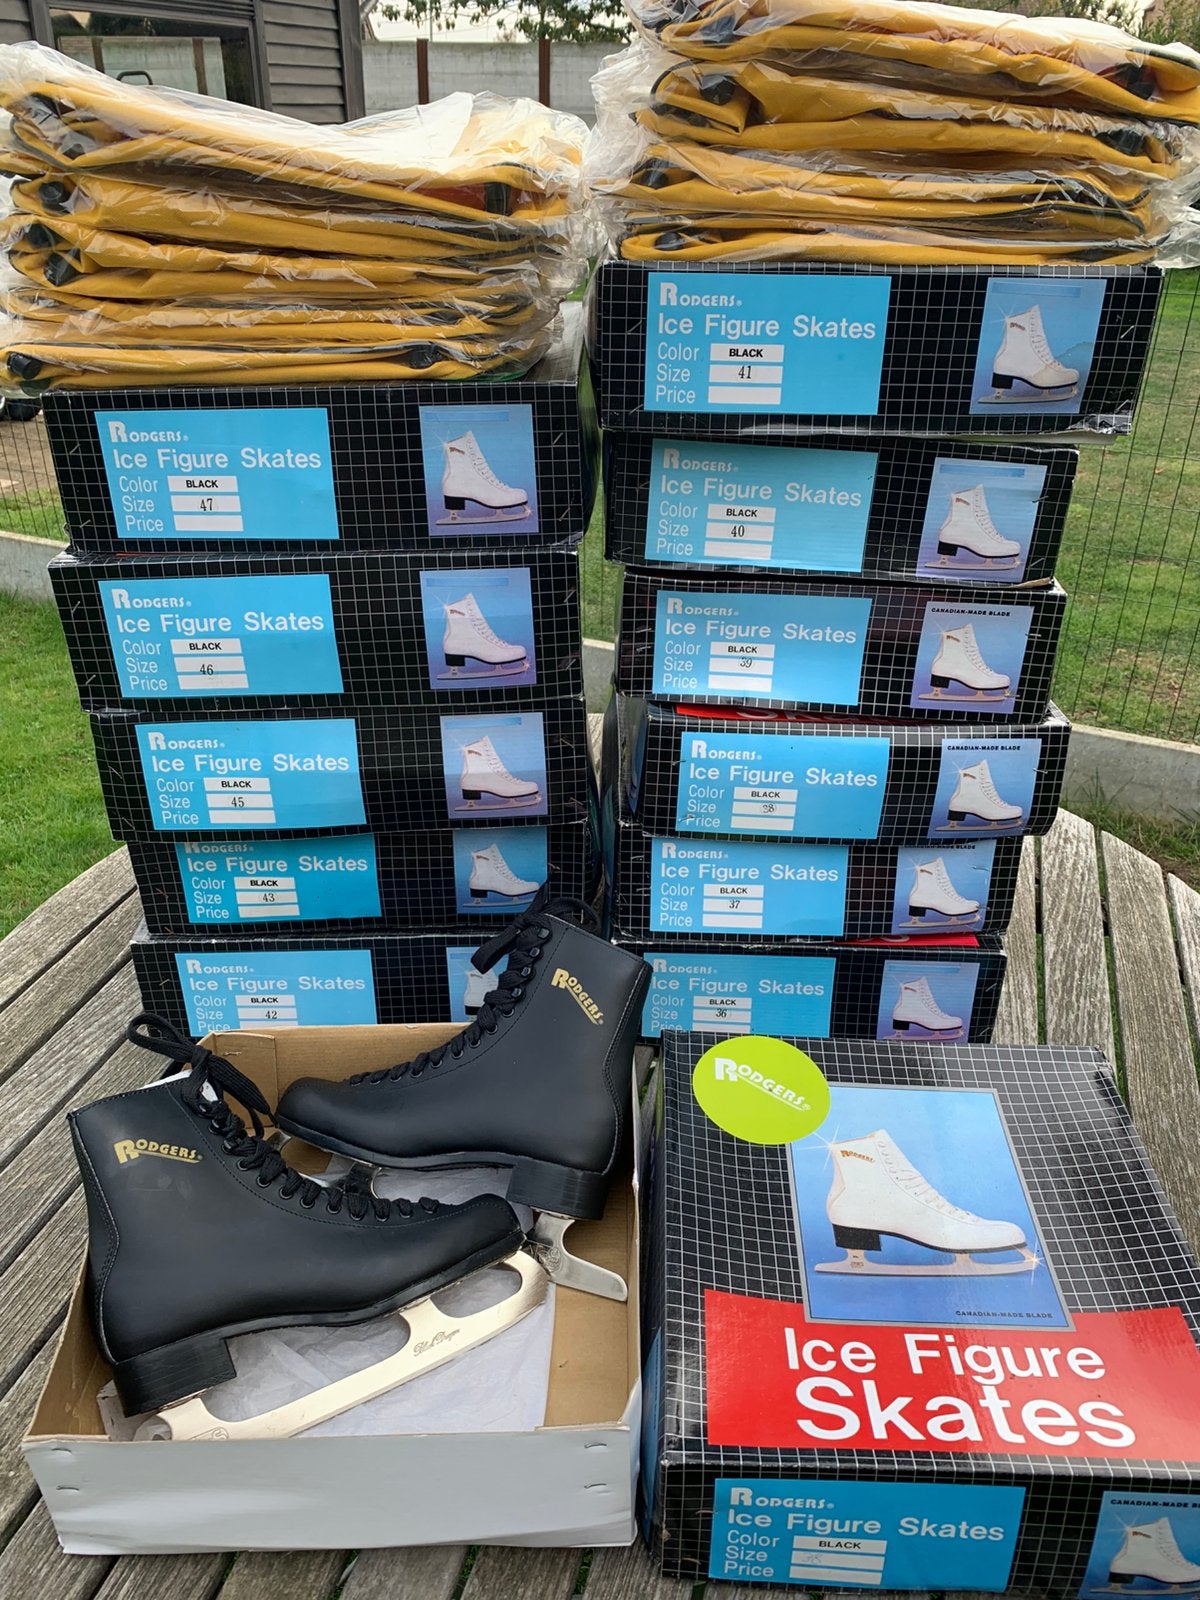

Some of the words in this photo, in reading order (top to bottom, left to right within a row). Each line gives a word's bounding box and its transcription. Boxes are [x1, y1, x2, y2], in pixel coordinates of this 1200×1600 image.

[660, 282, 735, 307] RODGERS
[658, 313, 693, 334] Ice
[705, 314, 779, 340] Figure
[793, 315, 876, 339] Skates
[658, 342, 699, 361] Color
[729, 349, 763, 357] BLACK
[657, 364, 690, 382] Size
[738, 366, 751, 379] 41
[656, 385, 696, 403] Price
[108, 421, 182, 443] RODGERS
[113, 449, 147, 468] Ice
[157, 449, 228, 472] Figure
[241, 448, 321, 468] Skates
[663, 448, 732, 472] RODGERS
[119, 476, 158, 492] Color
[185, 480, 218, 488] BLACK
[661, 475, 693, 495] Ice
[704, 478, 773, 501] Figure
[784, 483, 862, 506] Skates
[123, 495, 154, 512] Size
[200, 498, 213, 511] 47
[660, 501, 698, 519] Color
[726, 509, 757, 517] BLACK
[126, 515, 164, 532] Price
[658, 520, 688, 536] Size
[731, 525, 745, 537] 40
[657, 538, 693, 556] Price
[112, 589, 184, 609] RODGERS
[667, 598, 733, 616] RODGERS
[117, 615, 150, 632] Ice
[160, 614, 231, 636] Figure
[244, 612, 324, 631] Skates
[666, 619, 696, 635] Ice
[706, 621, 771, 639] Figure
[783, 624, 856, 643] Skates
[122, 640, 160, 654] Color
[189, 642, 222, 650] BLACK
[666, 641, 701, 655] Color
[728, 646, 757, 654] BLACK
[127, 658, 157, 673] Size
[200, 665, 213, 675] 46
[664, 657, 692, 671] Size
[130, 676, 168, 691] Price
[663, 673, 697, 689] Price
[148, 732, 218, 750] RODGERS
[692, 740, 756, 760] RODGERS
[152, 755, 184, 772] Ice
[194, 755, 261, 774] Figure
[274, 754, 349, 771] Skates
[690, 763, 719, 779] Ice
[730, 766, 794, 785] Figure
[805, 768, 877, 787] Skates
[157, 778, 194, 792] Color
[689, 784, 724, 799] Color
[160, 795, 190, 809] Size
[231, 797, 244, 807] 45
[688, 800, 716, 813] Size
[163, 811, 199, 825] Price
[662, 843, 722, 859] RODGERS
[188, 858, 216, 872] Ice
[226, 857, 288, 874] Figure
[299, 856, 368, 871] Skates
[661, 863, 688, 878] Ice
[699, 864, 759, 882] Figure
[771, 865, 838, 881] Skates
[191, 877, 225, 889] Color
[661, 883, 694, 896] Color
[194, 892, 221, 904] Size
[263, 893, 275, 903] 43
[660, 898, 687, 912] Size
[729, 900, 740, 909] 37
[196, 906, 229, 919] Price
[660, 913, 692, 927] Price
[186, 959, 249, 974] RODGERS
[653, 959, 712, 974] RODGERS
[190, 978, 218, 991] Ice
[227, 977, 288, 993] Figure
[298, 976, 365, 990] Skates
[652, 977, 679, 990] Ice
[689, 979, 747, 994] Figure
[759, 980, 824, 996] Skates
[194, 995, 226, 1008] Color
[551, 968, 603, 1020] RODGERS
[652, 994, 685, 1007] Color
[196, 1008, 223, 1020] Size
[265, 1011, 277, 1019] 42
[652, 1007, 677, 1020] Size
[716, 1008, 727, 1018] 36
[714, 1057, 806, 1109] RODGERS
[114, 1138, 197, 1164] RODGERS
[785, 1327, 876, 1374] Ice
[904, 1332, 1106, 1386] Figure
[796, 1377, 1136, 1447] Skates
[731, 1487, 826, 1509] RODGERS
[1111, 1499, 1188, 1508] CANADIAN-MADE
[728, 1509, 772, 1526] Ice
[787, 1513, 881, 1535] Figure
[899, 1517, 1004, 1540] Skates
[728, 1530, 779, 1548] Color
[819, 1540, 861, 1549] BLACK
[726, 1546, 767, 1561] Size
[724, 1561, 774, 1577] Price
